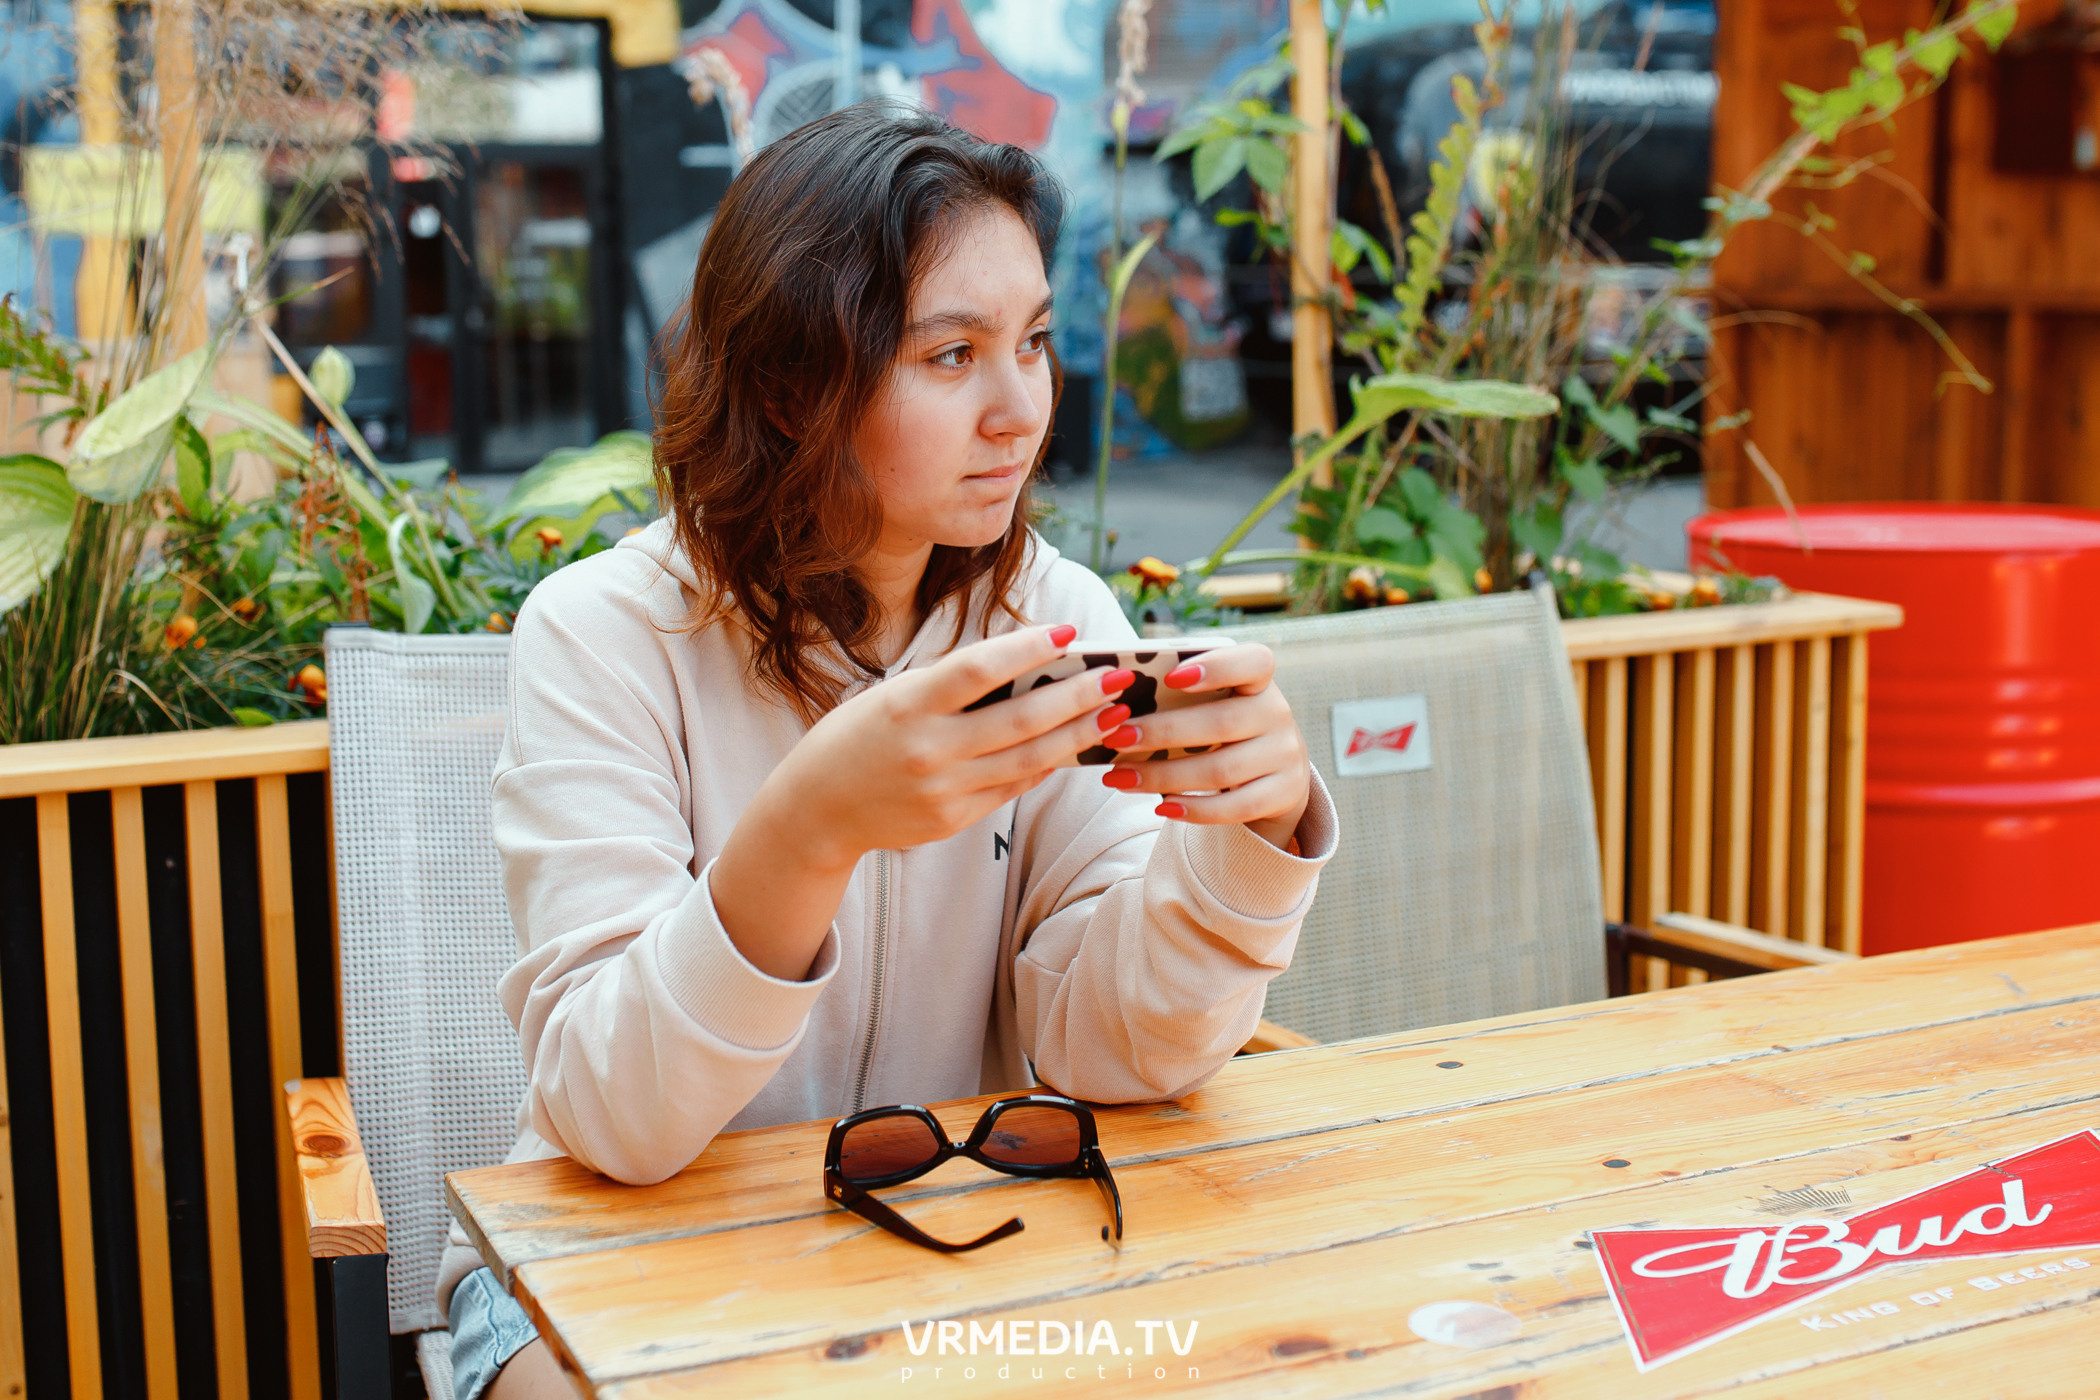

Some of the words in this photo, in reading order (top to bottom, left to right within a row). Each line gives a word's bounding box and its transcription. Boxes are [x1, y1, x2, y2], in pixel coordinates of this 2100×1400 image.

[1631, 1179, 2053, 1299] Bud
[1800, 1301, 1900, 1332] KING
[1910, 1286, 1955, 1306] OF
[1967, 1257, 2092, 1292] BEERS
